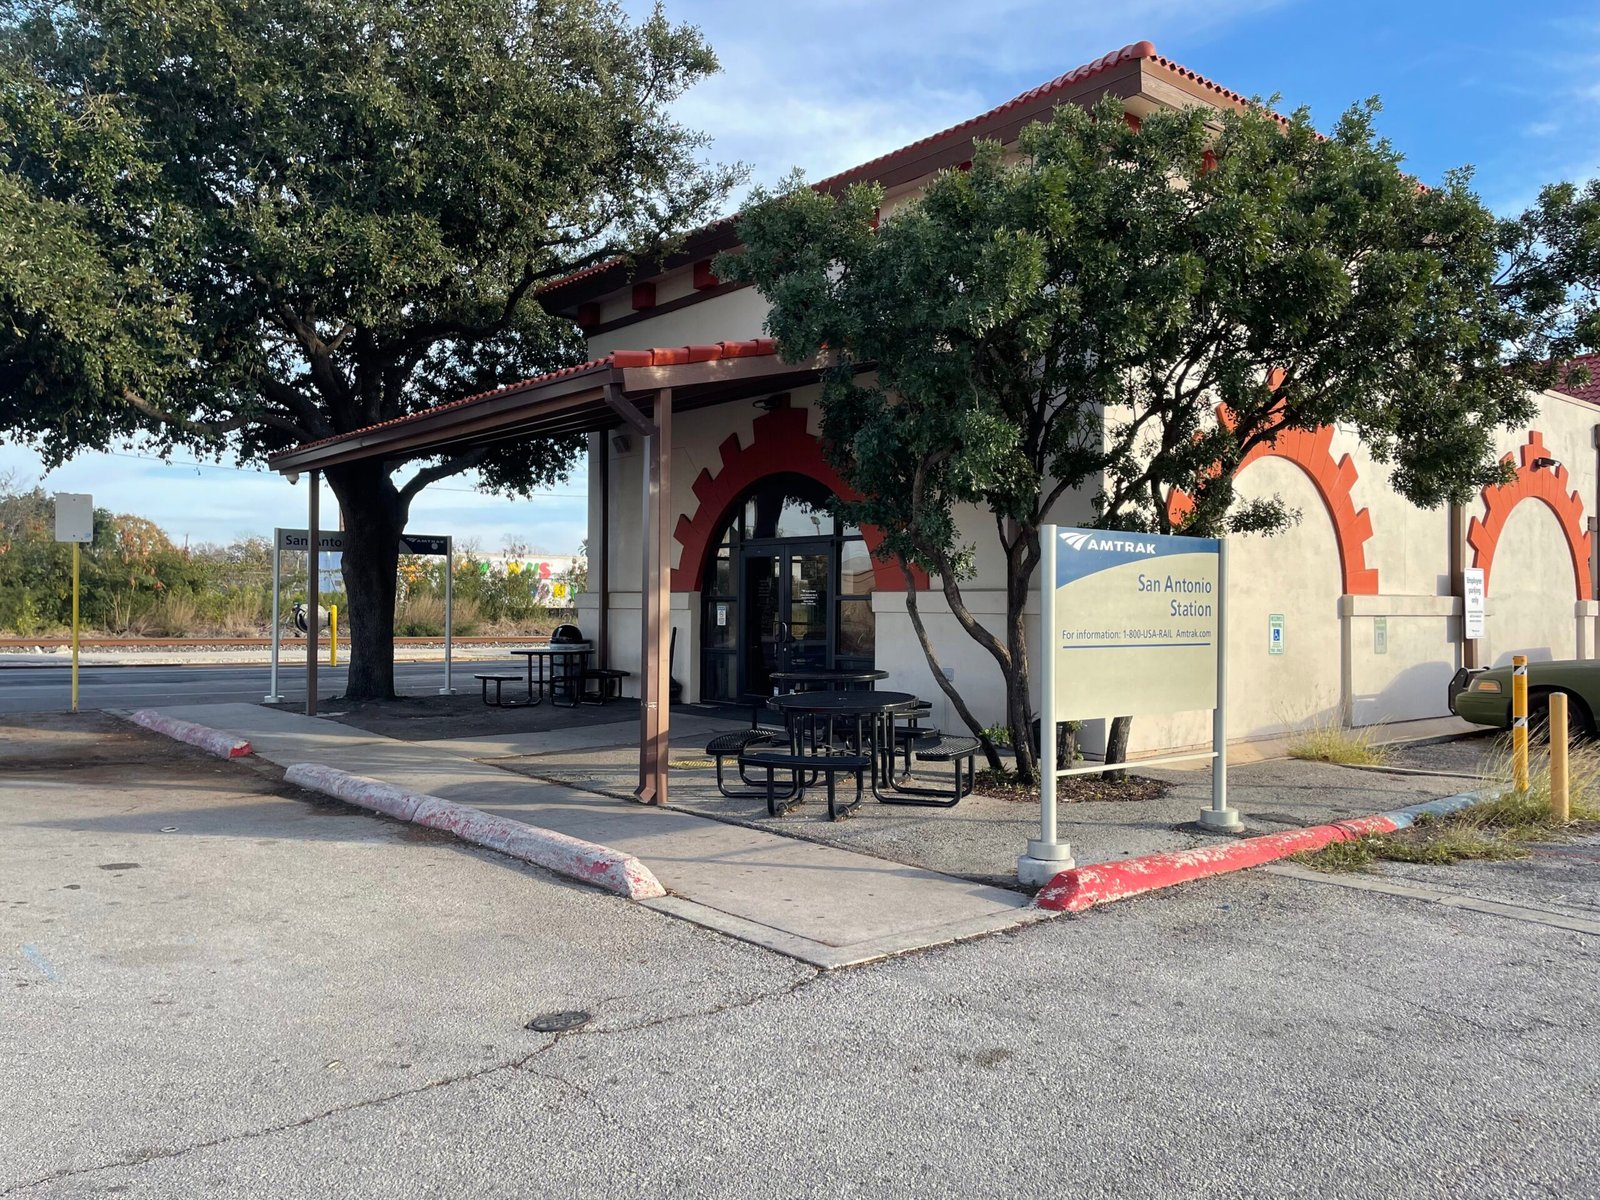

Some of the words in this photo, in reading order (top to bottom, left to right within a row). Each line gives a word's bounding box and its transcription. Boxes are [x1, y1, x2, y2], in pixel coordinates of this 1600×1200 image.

[286, 535, 308, 546] San
[1087, 539, 1156, 554] AMTRAK
[1138, 574, 1161, 592] San
[1164, 575, 1212, 593] Antonio
[1170, 599, 1212, 617] Station
[1062, 630, 1076, 639] For
[1076, 629, 1121, 639] information:
[1123, 629, 1173, 639] 1-800-USA-RAIL
[1175, 629, 1212, 638] Amtrak.com
